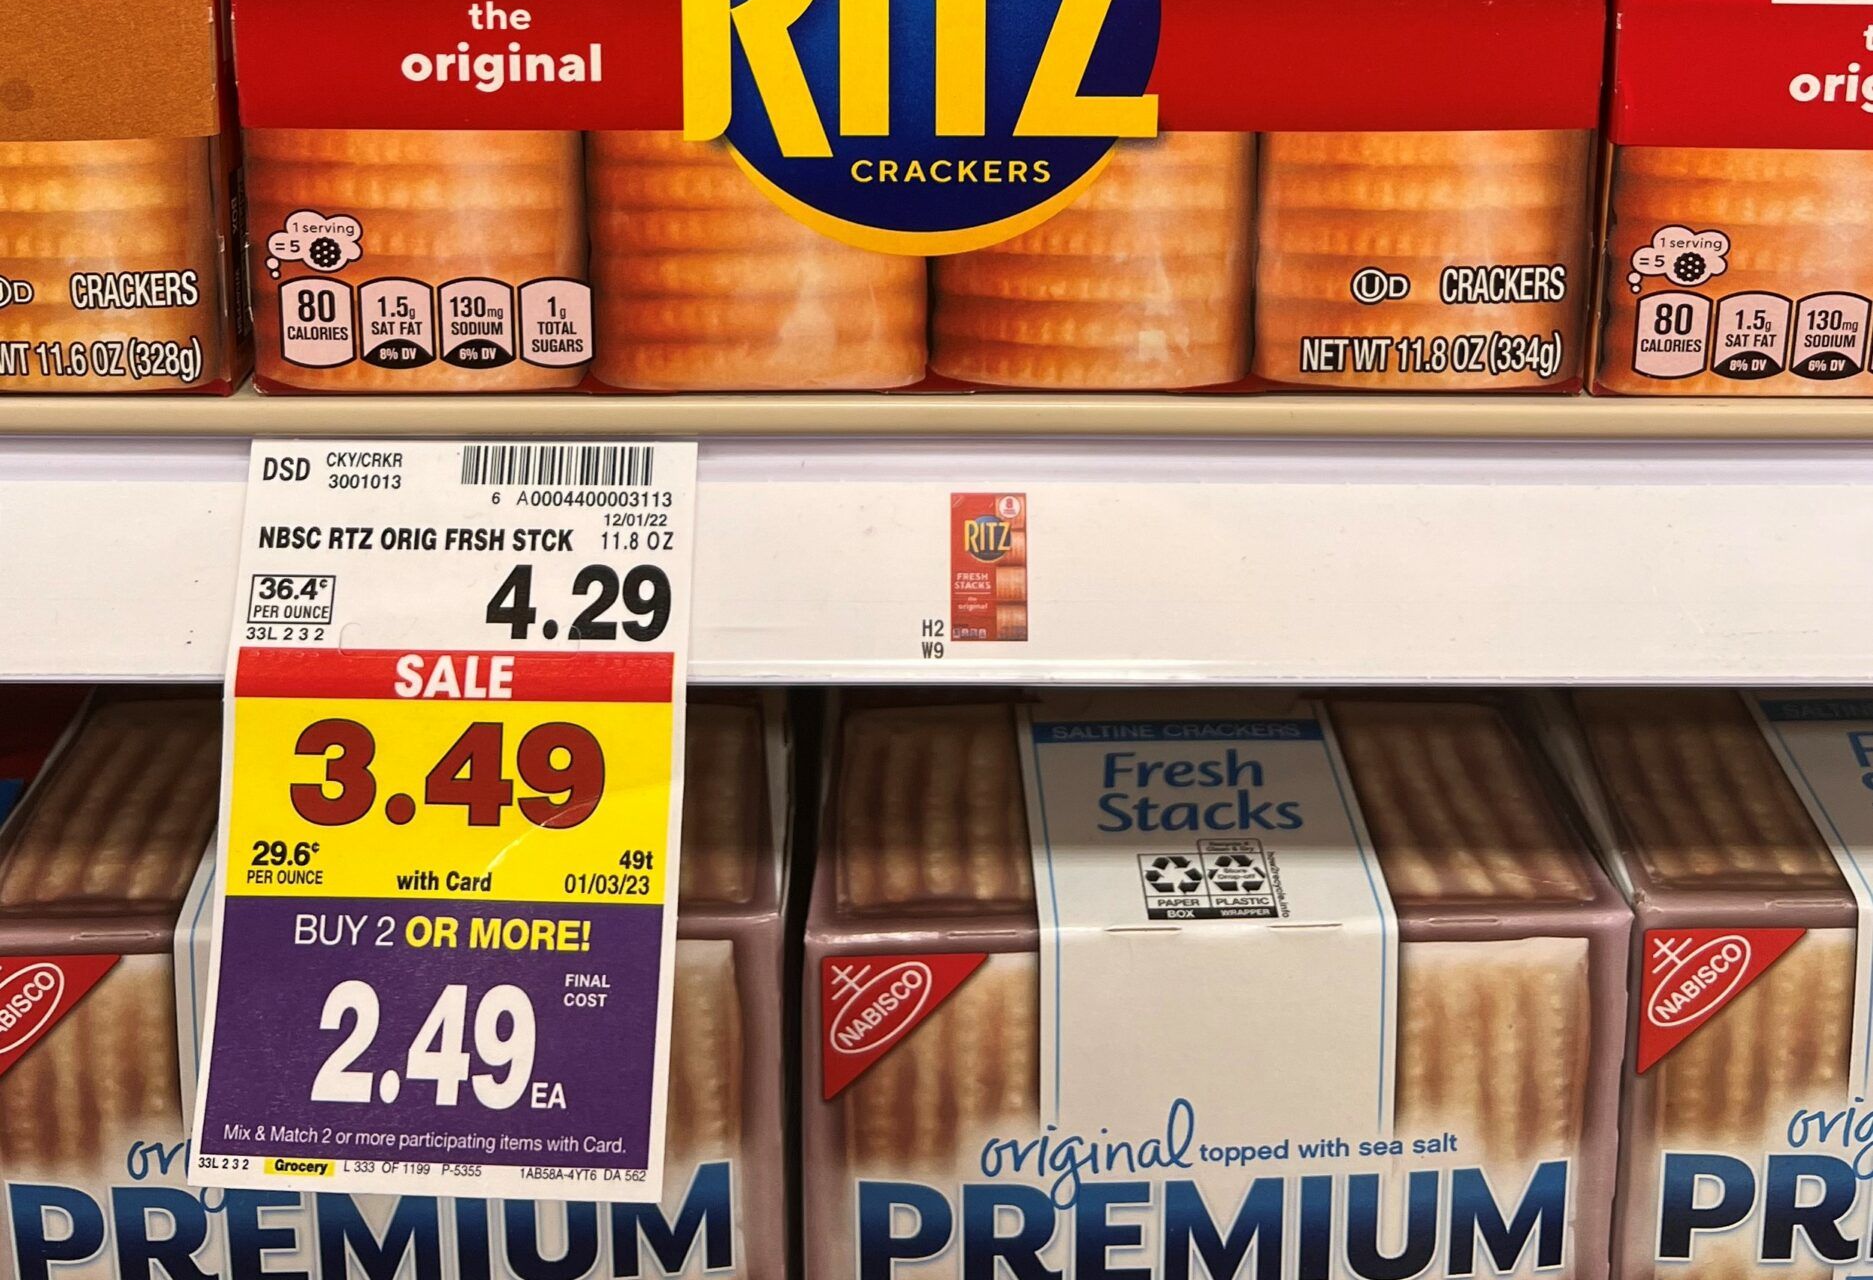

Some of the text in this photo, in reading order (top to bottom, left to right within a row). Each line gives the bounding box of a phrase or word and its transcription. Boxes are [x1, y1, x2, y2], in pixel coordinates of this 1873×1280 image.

[468, 2, 531, 31] the
[401, 42, 603, 93] original
[851, 160, 1051, 184] CRACKERS
[302, 222, 355, 236] serving
[71, 271, 198, 308] CRACKERS
[1442, 267, 1566, 302] CRACKERS
[298, 289, 335, 323] 80
[371, 321, 423, 336] SAT FAT
[451, 322, 503, 335] SODIUM
[537, 322, 577, 335] TOTAL
[1654, 304, 1694, 335] 80
[287, 326, 349, 341] CALORIES
[532, 339, 584, 353] SUGARS
[1302, 333, 1562, 377] NET WT 11.8 OZ (334g)
[1641, 339, 1702, 353] CALORIES
[35, 338, 202, 382] 11.6 OZ (328g)
[263, 457, 311, 482] DSD
[326, 452, 403, 469] CKY/CRKR
[328, 474, 402, 489] 3001013
[604, 513, 668, 527] 12/01/22
[259, 526, 573, 551] NBSC RTZ ORIG FRSH STCK
[602, 531, 674, 550] 11.8 OZ
[964, 520, 1011, 553] RITZ
[253, 605, 329, 619] PER OUNCE
[485, 563, 672, 642] 4.29
[922, 619, 944, 637] H2
[922, 642, 944, 659] W9
[394, 654, 514, 699] SALE
[1053, 723, 1300, 739] SALTINE CRACKERS
[289, 718, 606, 830] 3.49
[1103, 748, 1263, 788] Fresh
[1098, 789, 1303, 832] Stacks
[619, 850, 654, 870] 49t
[247, 870, 323, 885] PER OUNCE
[397, 872, 492, 893] with Card
[565, 874, 650, 895] 01/03/23
[1158, 899, 1200, 907] PAPER
[1216, 897, 1270, 906] PLASTIC
[1167, 910, 1195, 918] BOX
[295, 914, 592, 952] BUY 2 OR MORE!
[565, 973, 610, 989] FINAL
[1655, 943, 1742, 1020] NABISCO
[564, 992, 607, 1008] COST
[838, 970, 922, 1047] NABISCO
[311, 980, 566, 1110] 2.49 EA
[224, 1124, 626, 1154] Mix & Match 2 or more participating items with Card.
[981, 1098, 1458, 1209] original topped with sea salt
[274, 1159, 328, 1175] Grocery
[381, 1161, 482, 1177] OF 1199 P-5355
[520, 1168, 646, 1182] 1AB58A-4YT6 DA 562
[9, 1162, 733, 1280] PREMIUM
[857, 1160, 1569, 1280] PREMIUM
